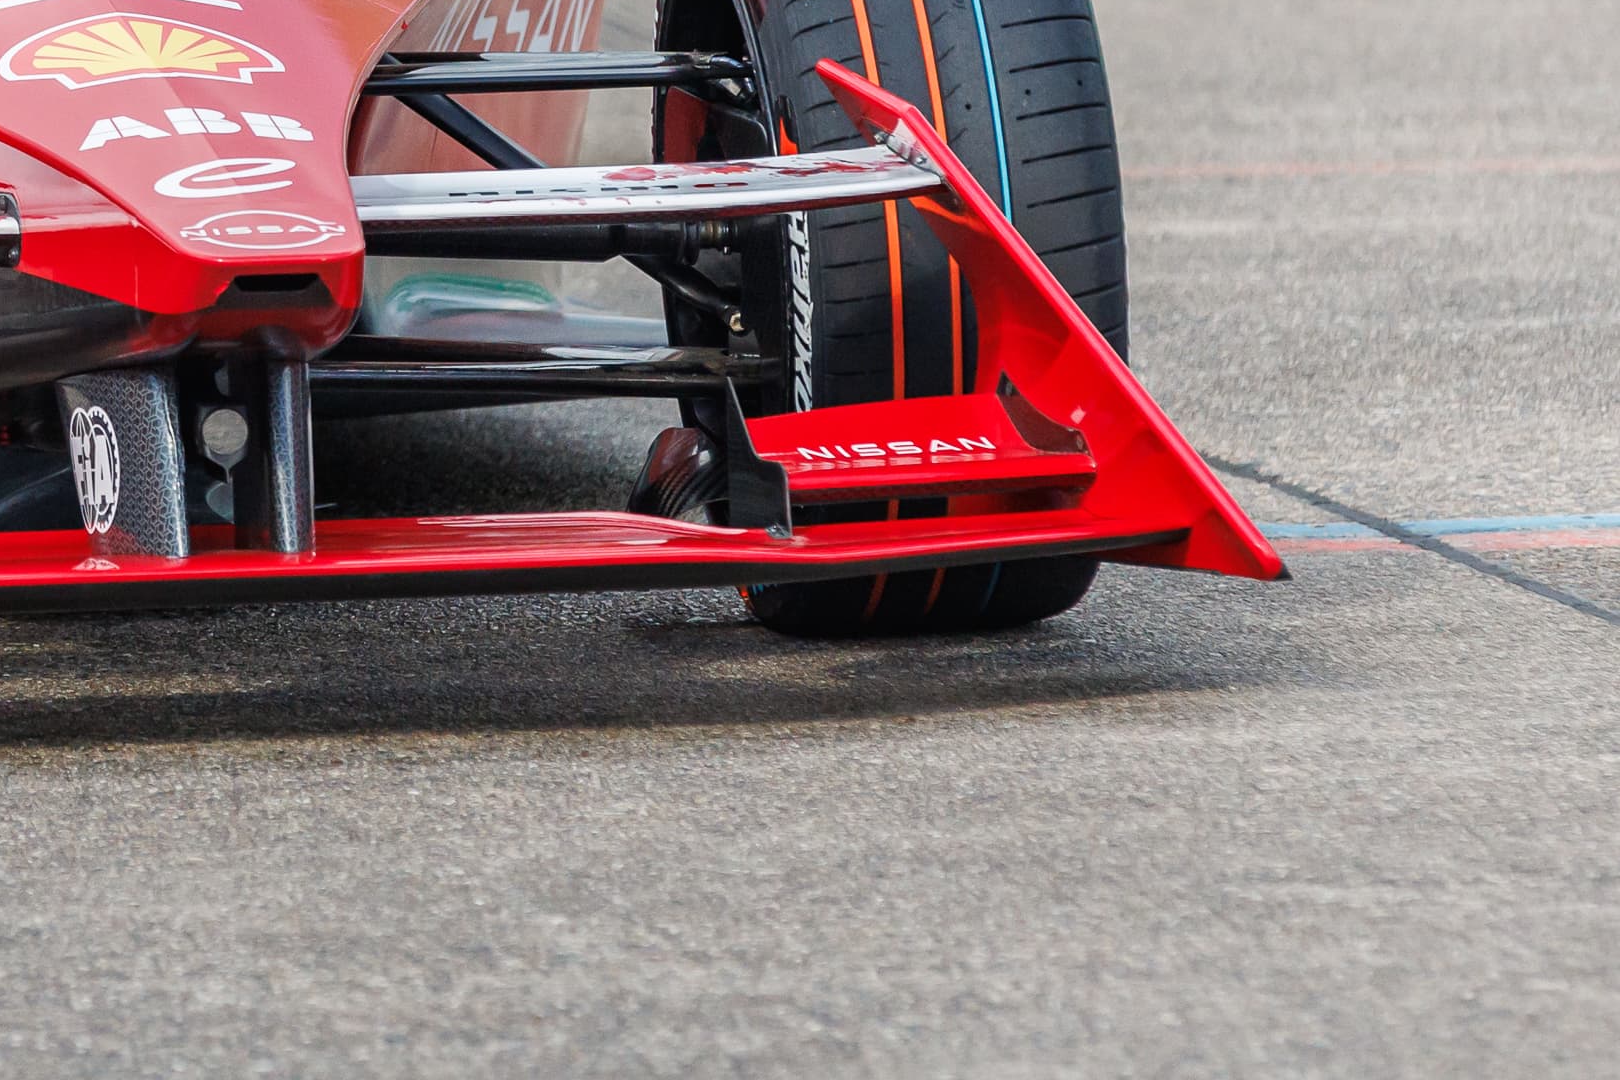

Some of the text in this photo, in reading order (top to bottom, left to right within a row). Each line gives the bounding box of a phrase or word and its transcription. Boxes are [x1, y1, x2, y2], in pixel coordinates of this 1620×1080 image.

[79, 107, 314, 151] ABB
[181, 223, 346, 241] NISSAN
[797, 435, 997, 461] NISSAN
